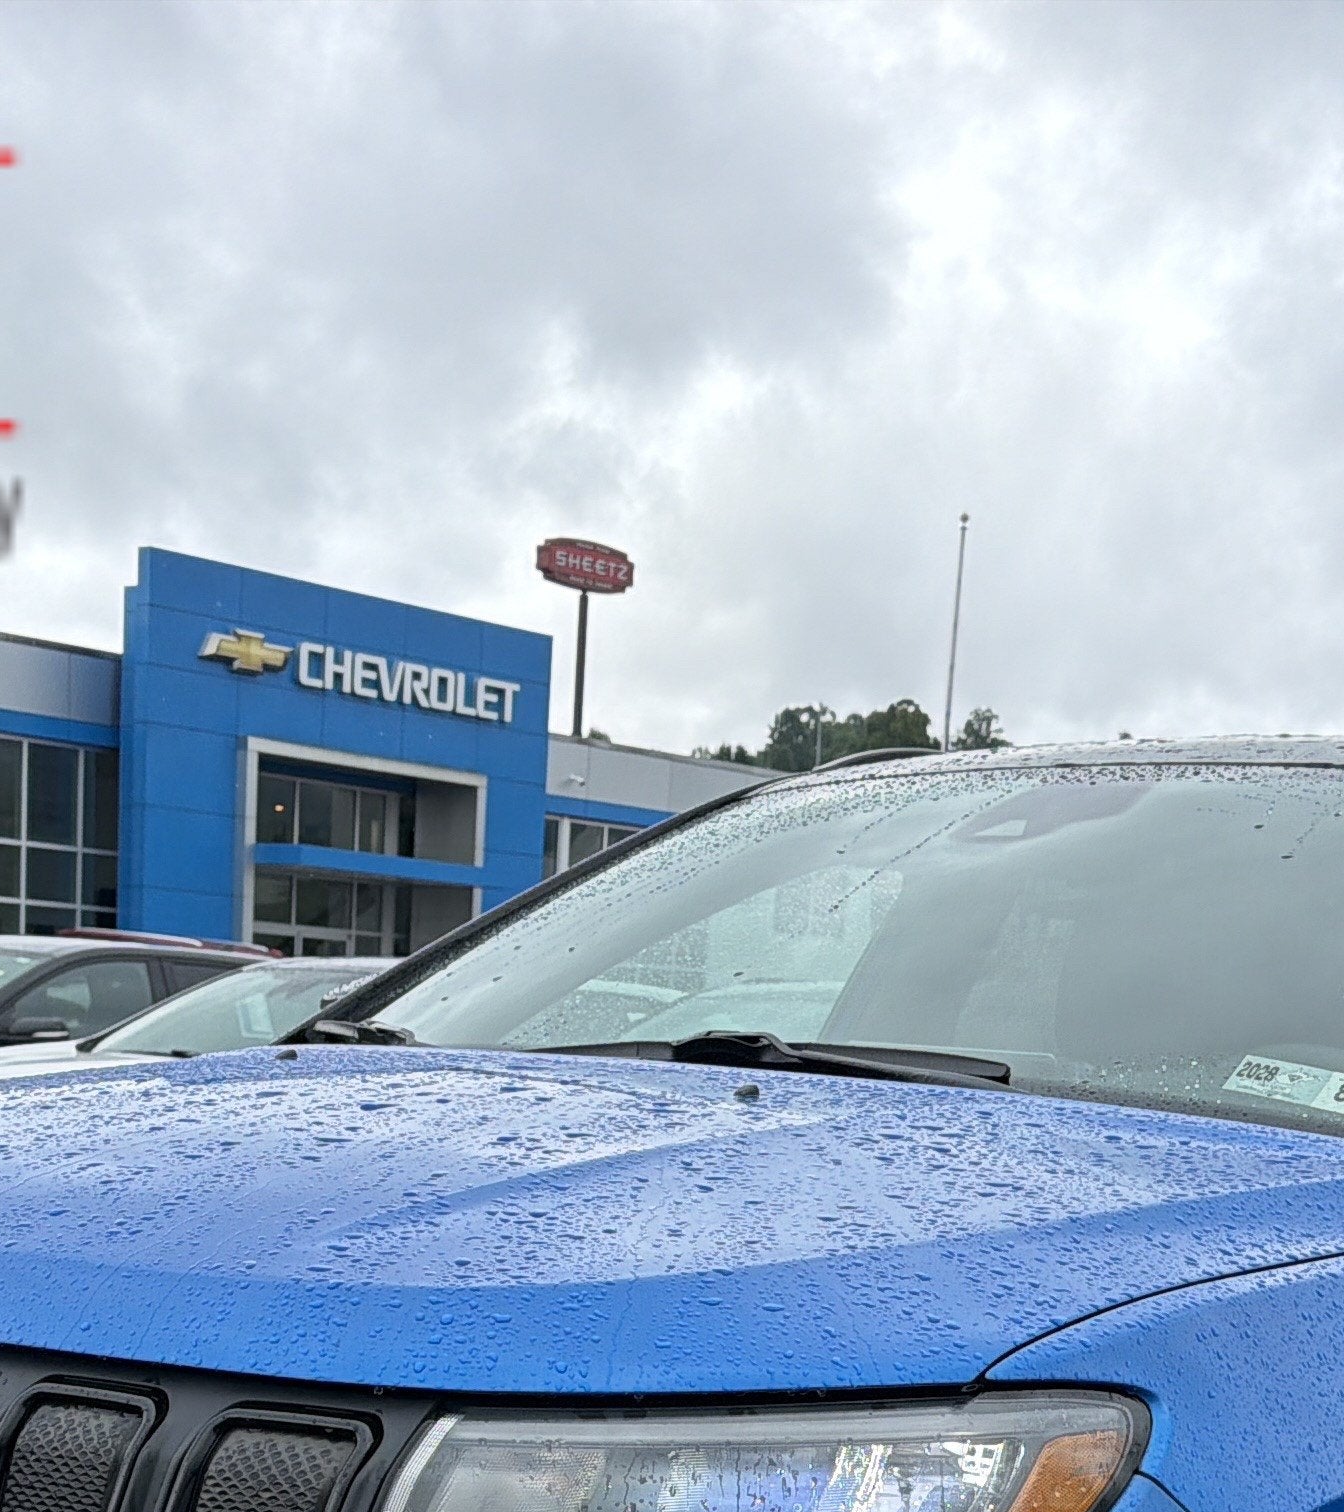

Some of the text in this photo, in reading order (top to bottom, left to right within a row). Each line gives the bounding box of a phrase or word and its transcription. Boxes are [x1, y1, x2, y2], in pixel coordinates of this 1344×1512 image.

[555, 549, 629, 580] SHEETZ
[298, 641, 521, 723] CHEVROLET
[1235, 1061, 1281, 1083] 2028
